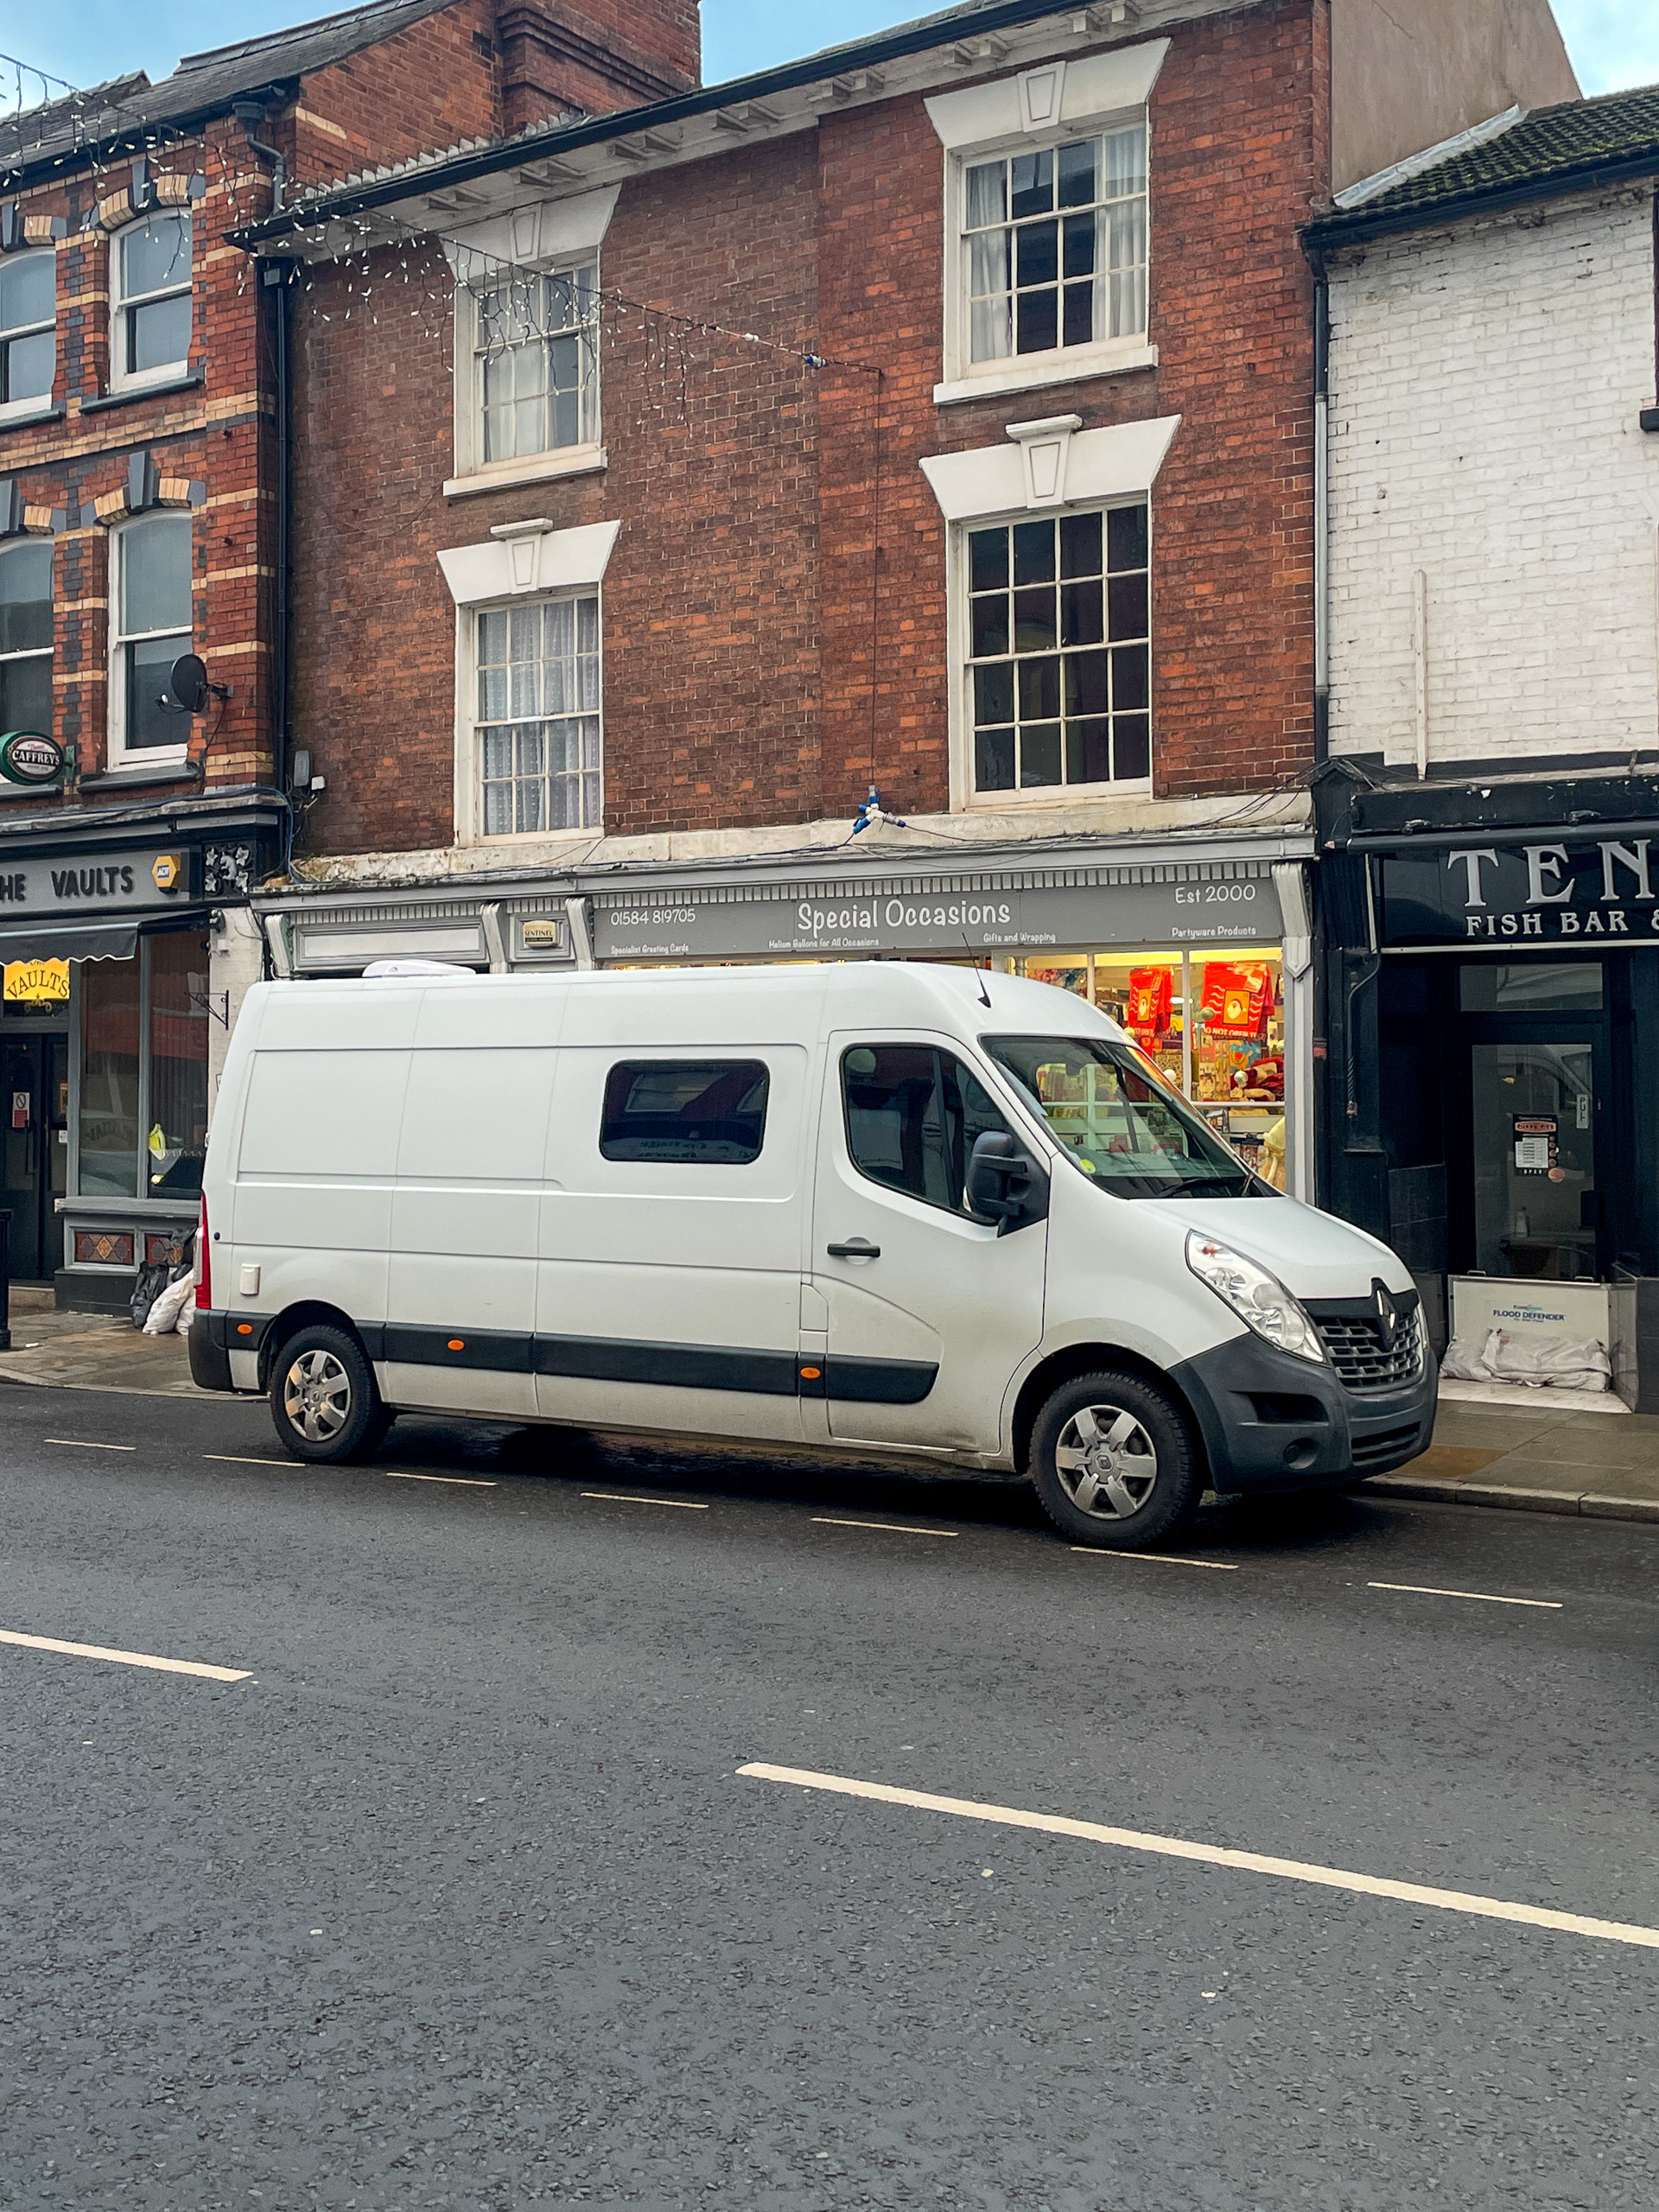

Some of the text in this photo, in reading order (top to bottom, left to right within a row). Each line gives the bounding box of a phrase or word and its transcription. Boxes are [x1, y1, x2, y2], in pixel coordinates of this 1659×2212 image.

[50, 865, 133, 898] VAULTS
[1447, 839, 1656, 907] TEN
[1175, 884, 1255, 904] Est 2000
[610, 908, 696, 926] 01584 819705
[798, 898, 1011, 938] Special Occasions
[1465, 913, 1542, 937] FISH
[1560, 911, 1628, 934] BAR
[983, 931, 1056, 944] Gifts and Wrapping
[1172, 925, 1256, 939] Partyware Products
[611, 943, 689, 957] Specialist Greeting Cards
[769, 939, 791, 949] Helium
[819, 938, 830, 947] for
[831, 937, 842, 947] All
[842, 937, 880, 947] Occasions
[6, 969, 69, 998] VAULTS
[1493, 1309, 1521, 1318] FLOOD
[1522, 1312, 1565, 1320] DEFENDER
